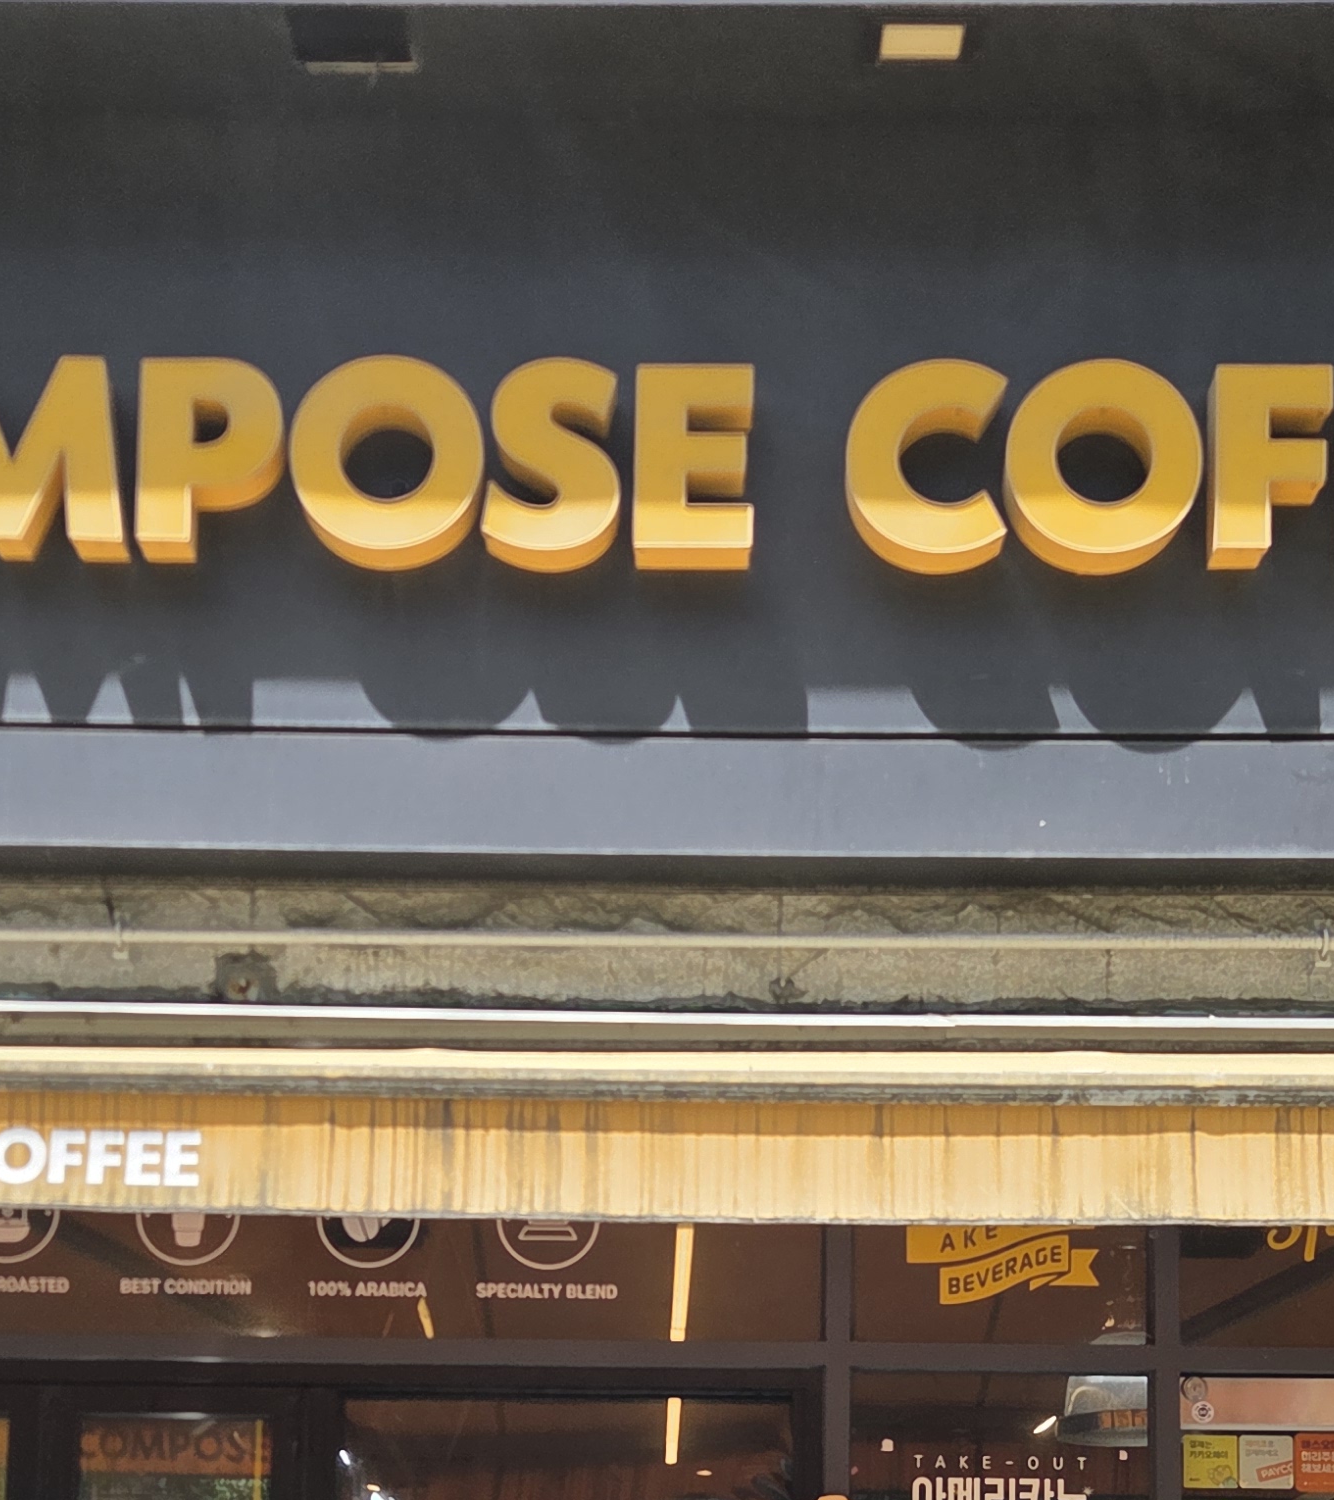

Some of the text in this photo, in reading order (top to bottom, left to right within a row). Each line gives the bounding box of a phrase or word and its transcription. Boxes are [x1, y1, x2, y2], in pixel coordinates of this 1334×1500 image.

[948, 1245, 1063, 1295] BEVERAGE
[120, 1278, 252, 1296] BEST CONDITION
[308, 1280, 427, 1298] 100% ARABICA
[476, 1283, 618, 1300] SPECIALTY BLEND
[914, 1455, 1088, 1470] TAKE-OUT
